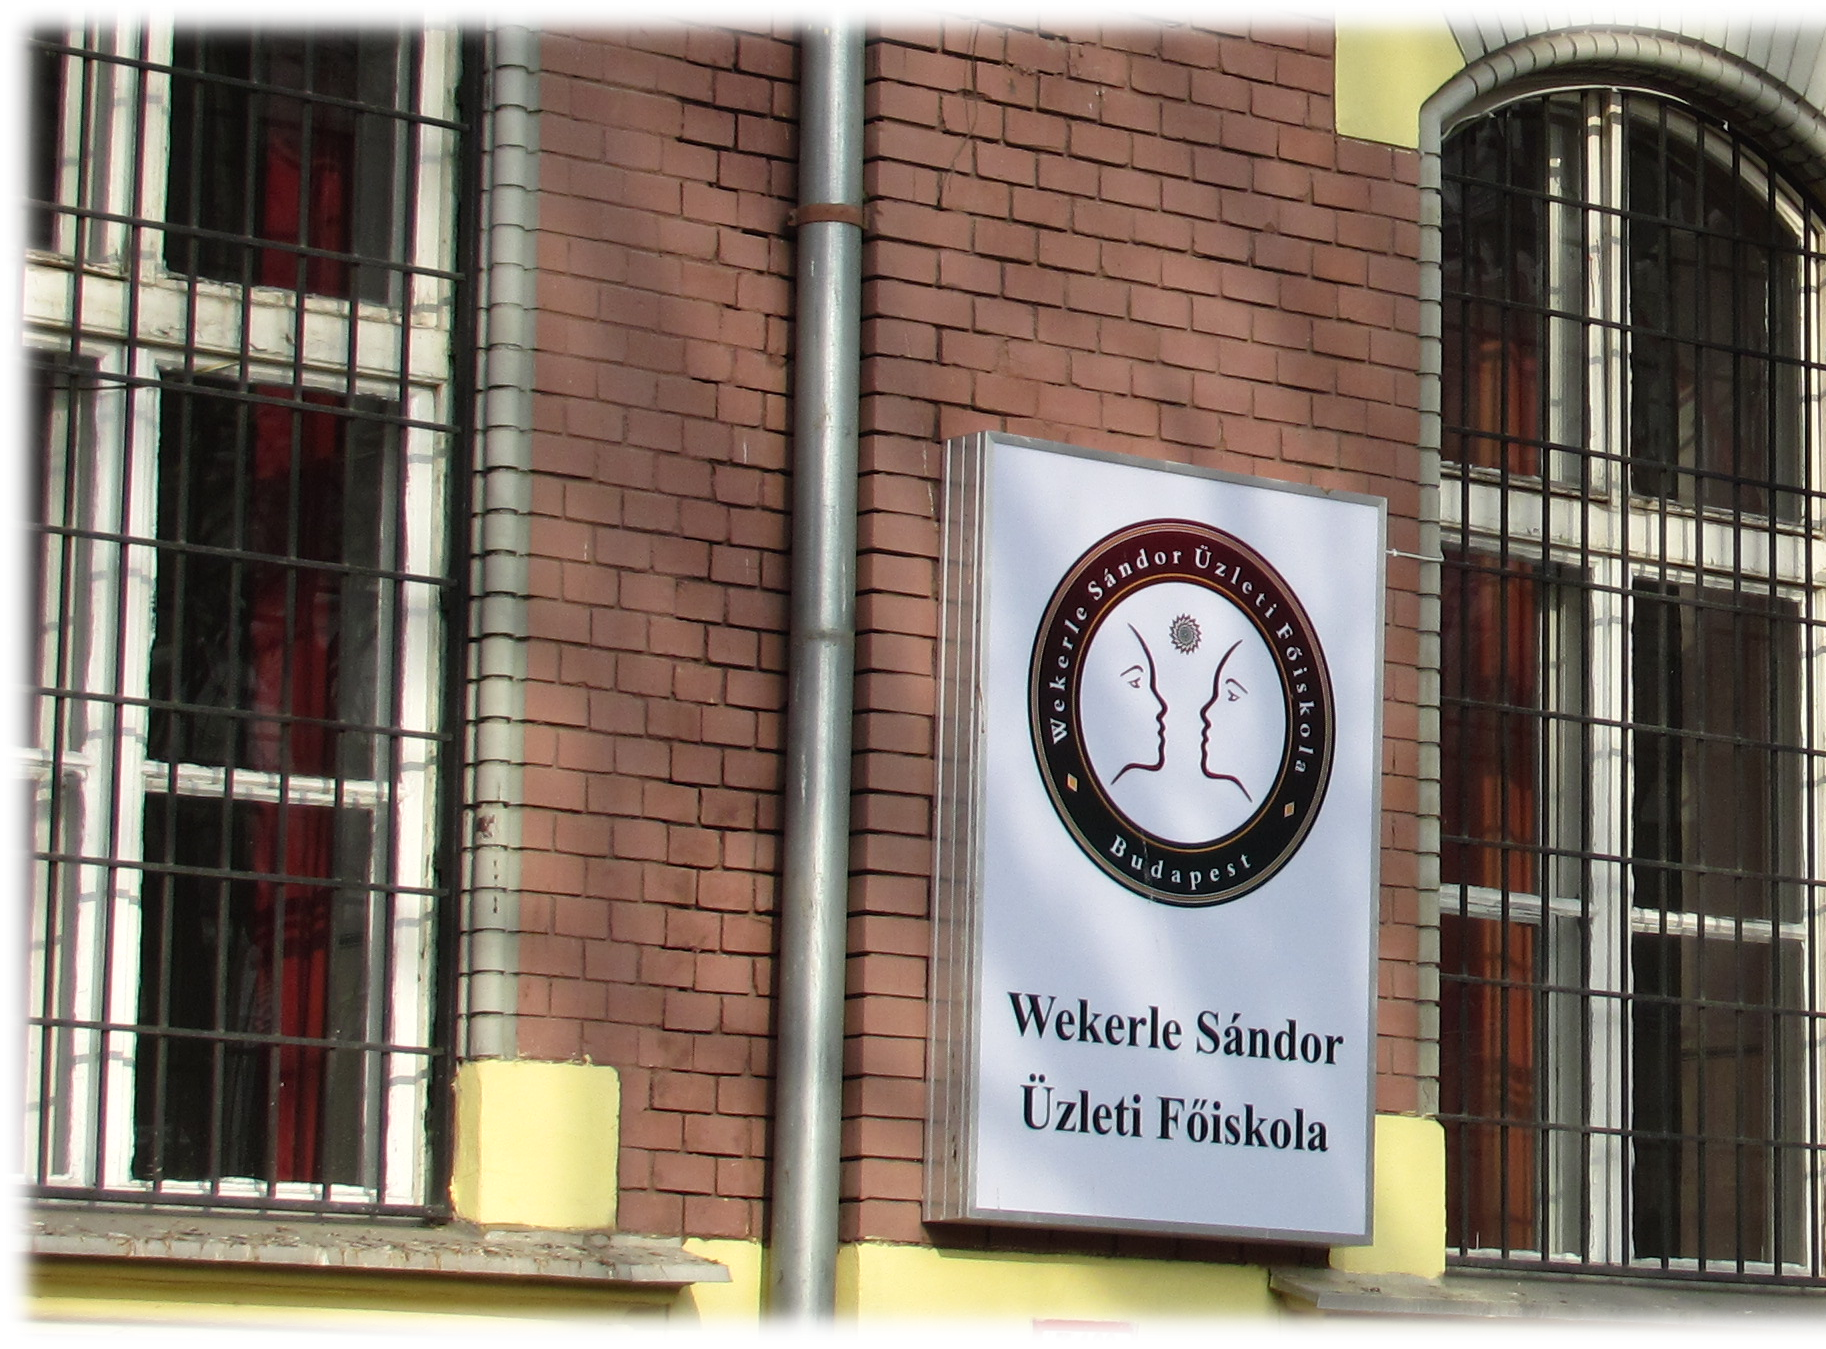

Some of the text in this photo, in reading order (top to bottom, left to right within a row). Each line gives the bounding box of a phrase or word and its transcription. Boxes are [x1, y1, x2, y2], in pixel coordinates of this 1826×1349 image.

[1049, 545, 1315, 774] Wekerle Sándor Üzleti Főiskola
[1109, 835, 1251, 890] Budapest
[1007, 991, 1344, 1065] Wekerle Sándor
[1020, 1073, 1328, 1152] Üzleti Főiskola
